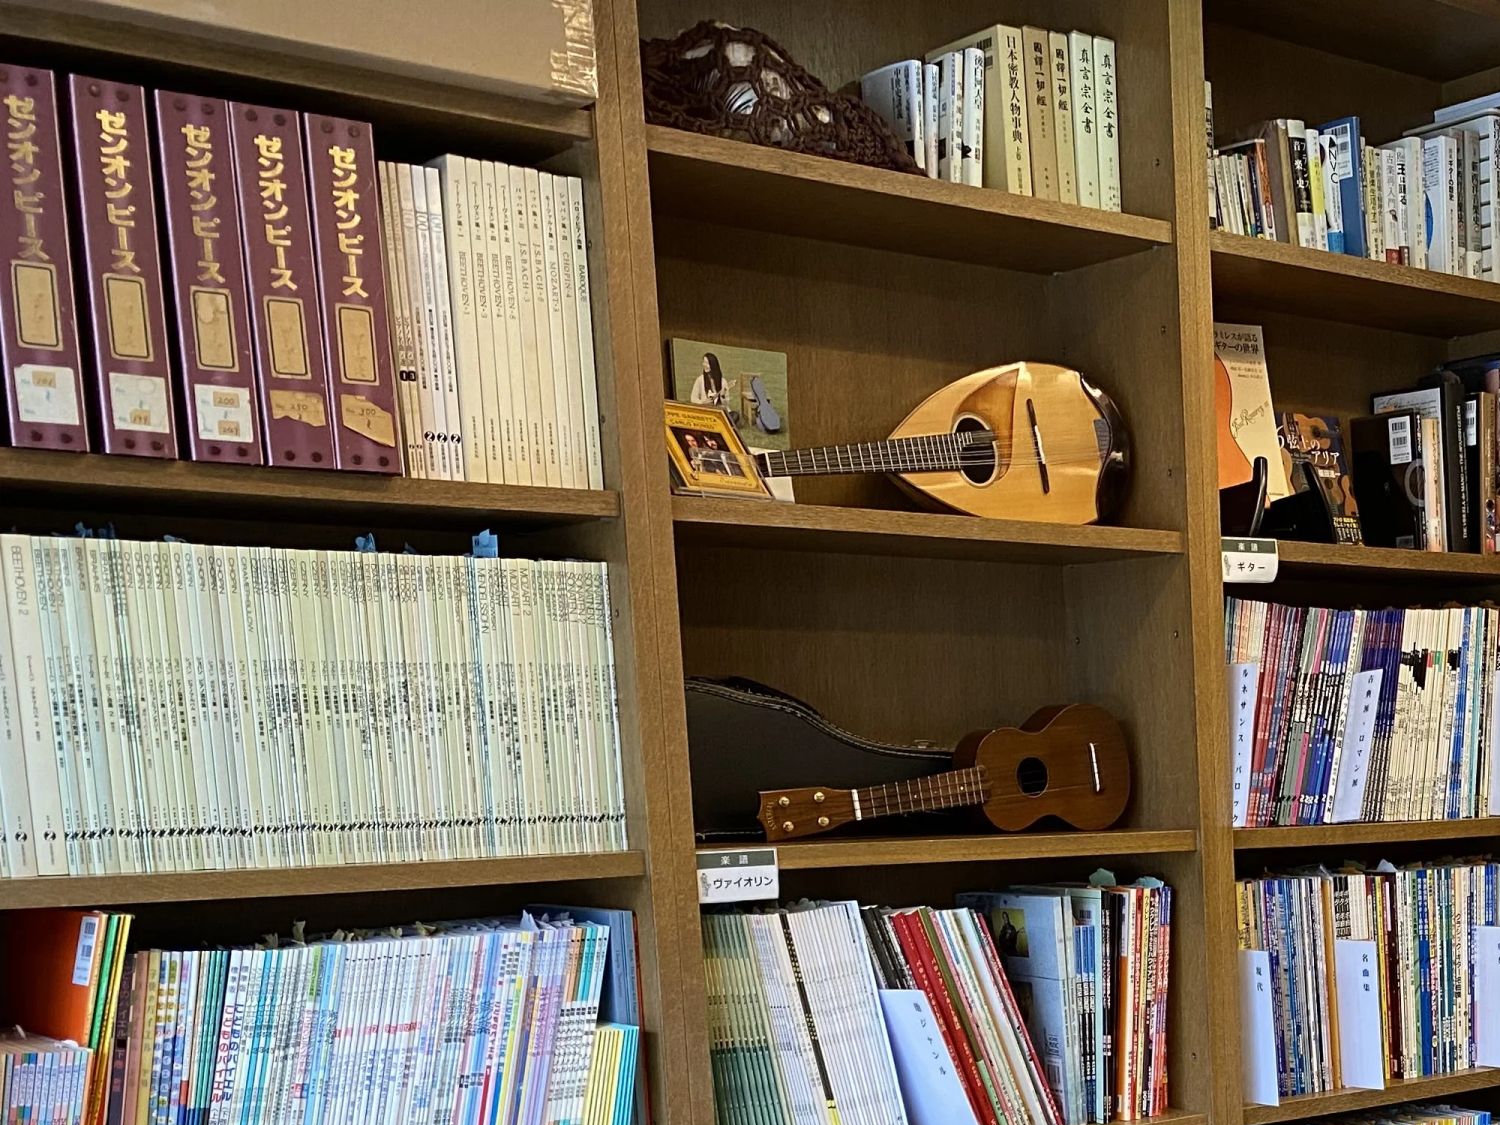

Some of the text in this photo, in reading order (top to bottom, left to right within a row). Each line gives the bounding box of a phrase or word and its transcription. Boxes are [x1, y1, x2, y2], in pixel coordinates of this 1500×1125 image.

[1006, 35, 1024, 144] 日本密教人物事典
[6, 94, 50, 261] ゼンオンピース
[95, 108, 142, 273] ゼンオンピース
[181, 124, 226, 284] ゼンオンピース
[254, 134, 298, 290] ゼンオンピース
[328, 145, 369, 298] ゼンオンピース
[1311, 452, 1340, 465] アリア
[1237, 562, 1265, 572] ギター
[1233, 669, 1249, 823] ルネサンス・バロック
[713, 877, 774, 889] ヴァイオリン
[1361, 953, 1371, 992] 名曲集
[913, 1002, 947, 1076] ジャンル
